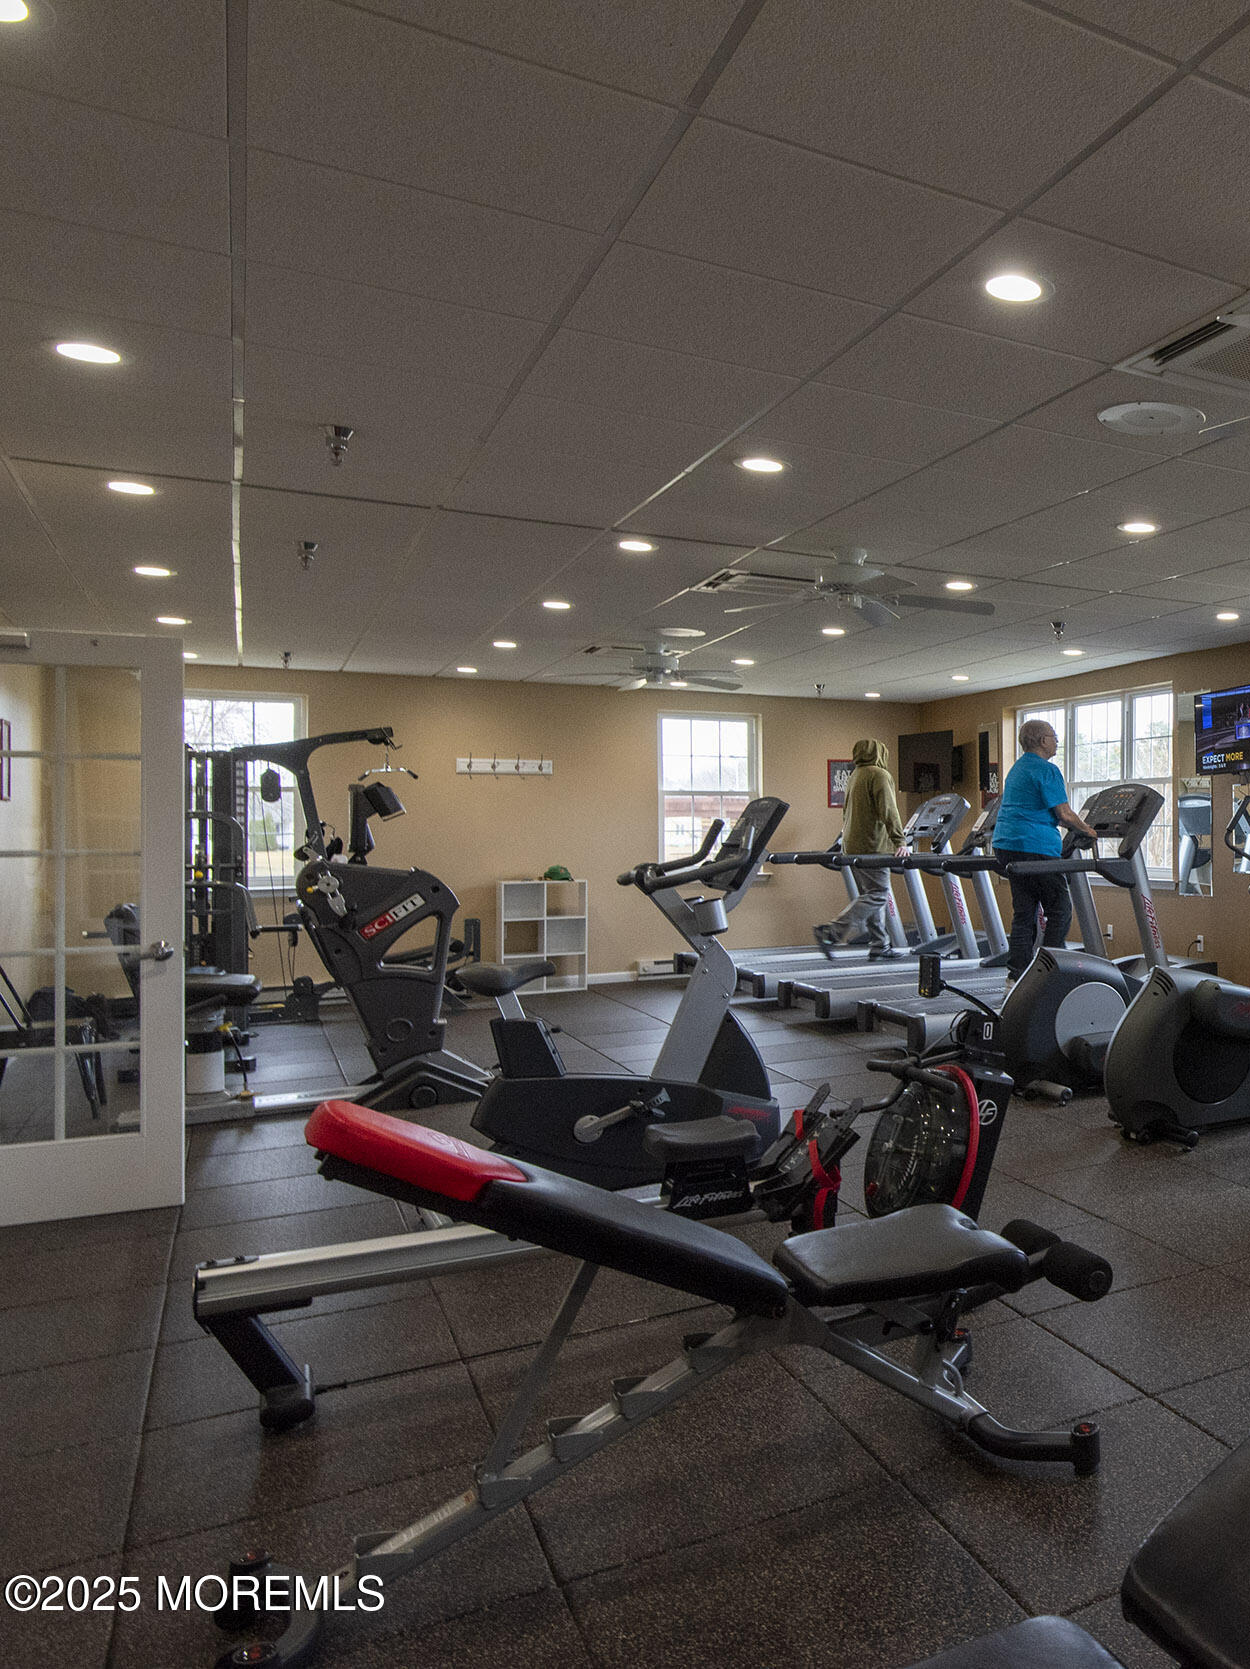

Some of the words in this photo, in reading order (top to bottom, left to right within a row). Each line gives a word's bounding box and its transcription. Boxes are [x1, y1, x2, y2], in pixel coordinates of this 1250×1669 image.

[1202, 753, 1225, 765] EXPECT
[1225, 751, 1244, 762] MORE
[364, 895, 419, 938] SCIFIT
